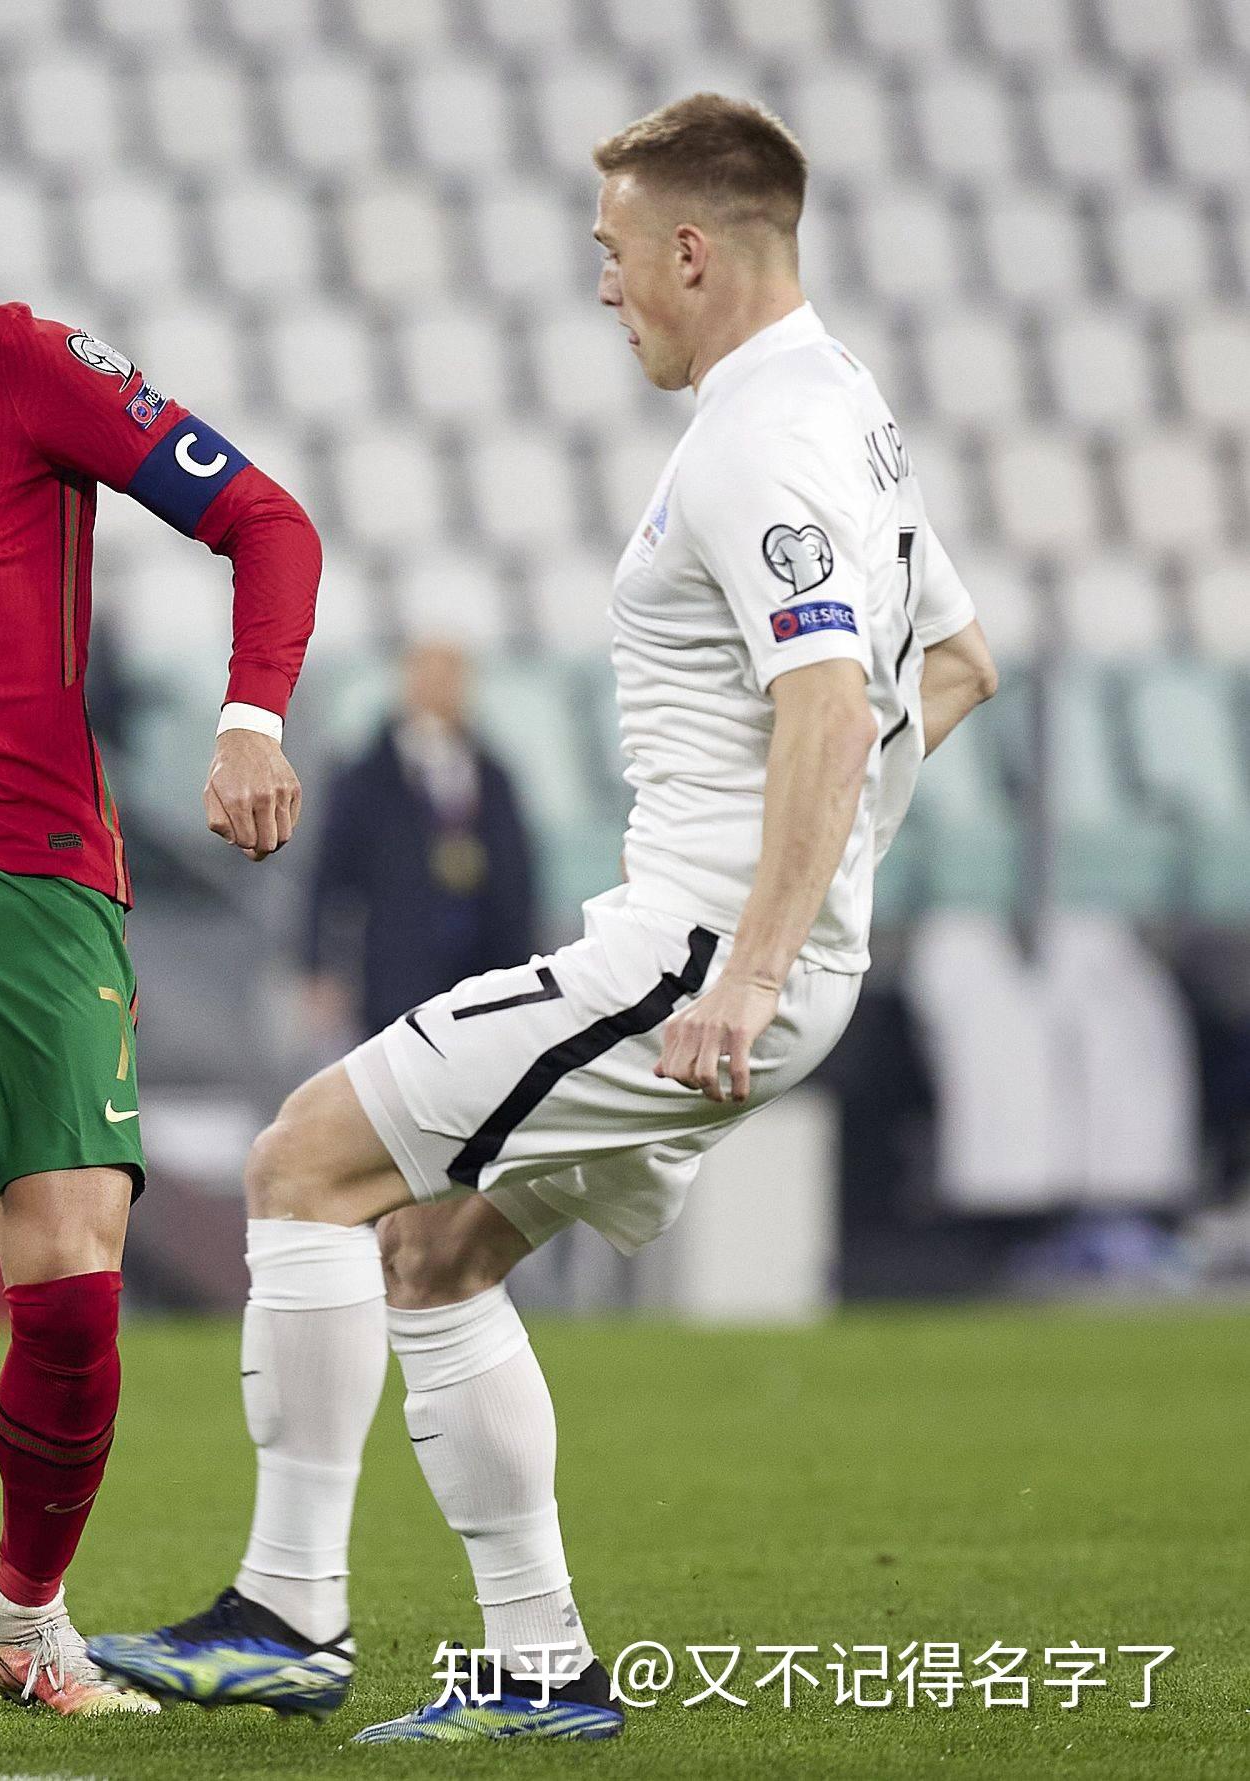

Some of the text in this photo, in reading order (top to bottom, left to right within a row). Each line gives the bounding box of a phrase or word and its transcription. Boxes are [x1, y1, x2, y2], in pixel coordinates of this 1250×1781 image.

[174, 431, 228, 478] C
[799, 607, 855, 626] RESPEC
[452, 966, 564, 1020] 7
[98, 986, 129, 1081] 7
